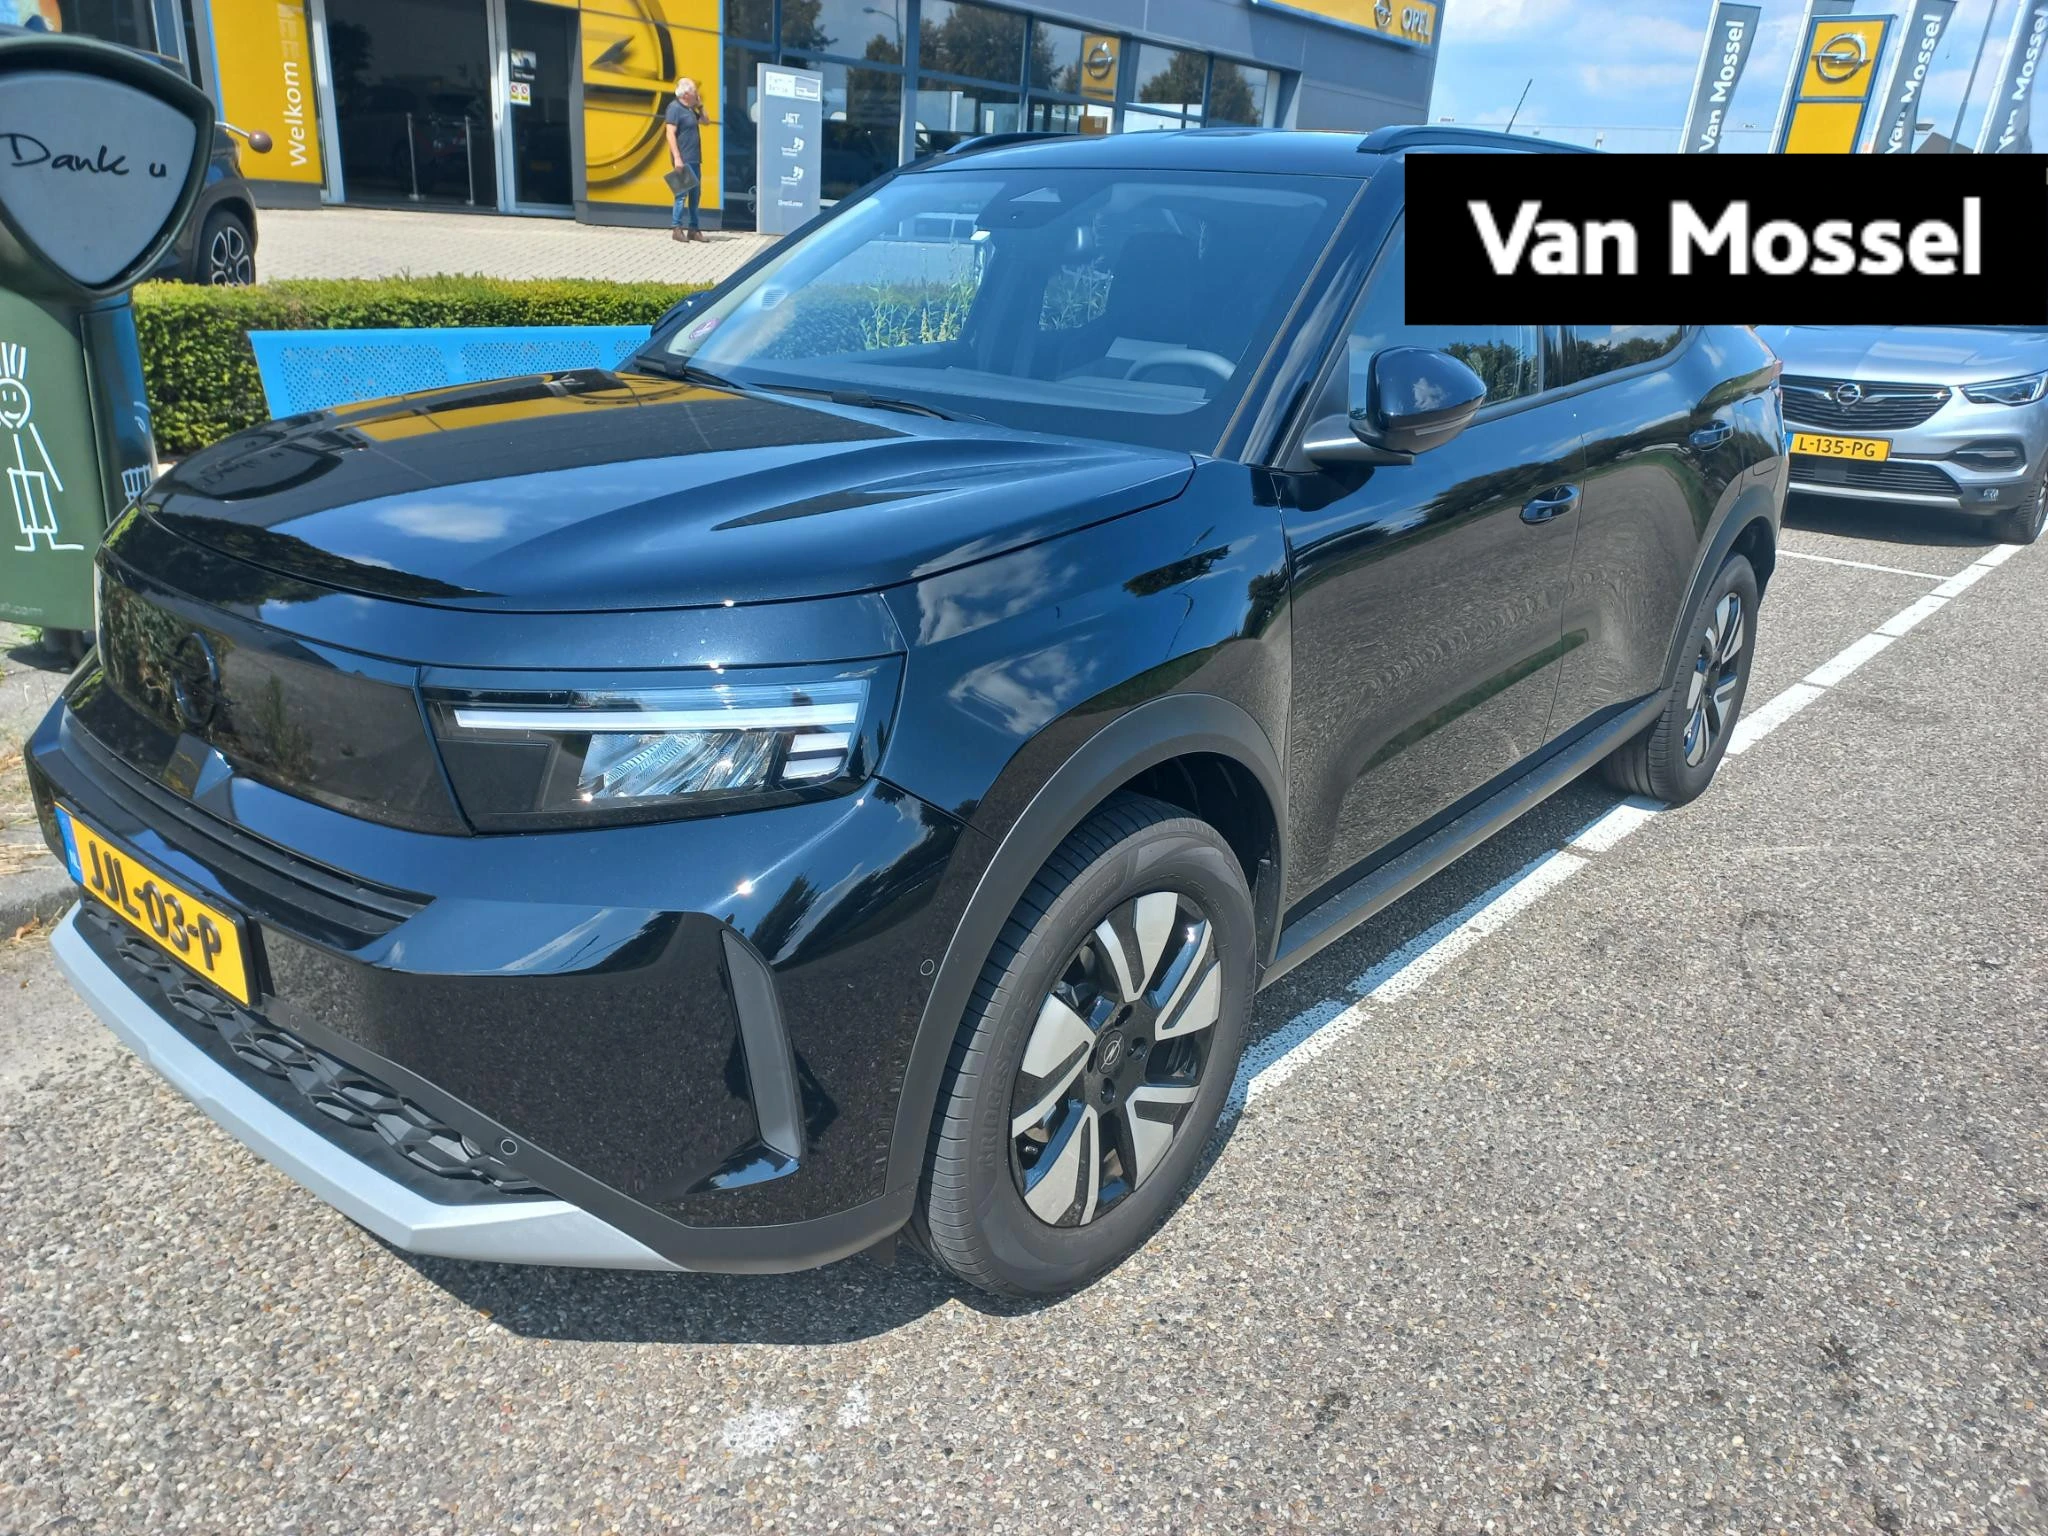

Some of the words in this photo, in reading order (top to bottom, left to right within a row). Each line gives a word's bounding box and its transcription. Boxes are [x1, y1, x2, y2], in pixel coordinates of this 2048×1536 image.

[1401, 6, 1430, 36] OPEL
[1709, 20, 1746, 103] Mossel
[1901, 14, 1943, 104] Mossel
[2012, 9, 2048, 101] Mossel
[0, 133, 129, 175] Dank
[149, 163, 167, 177] u
[283, 61, 308, 167] Welkom
[1699, 109, 1722, 152] Van
[1797, 436, 1876, 458] L-135-PG
[88, 840, 223, 972] JJL-03-P
